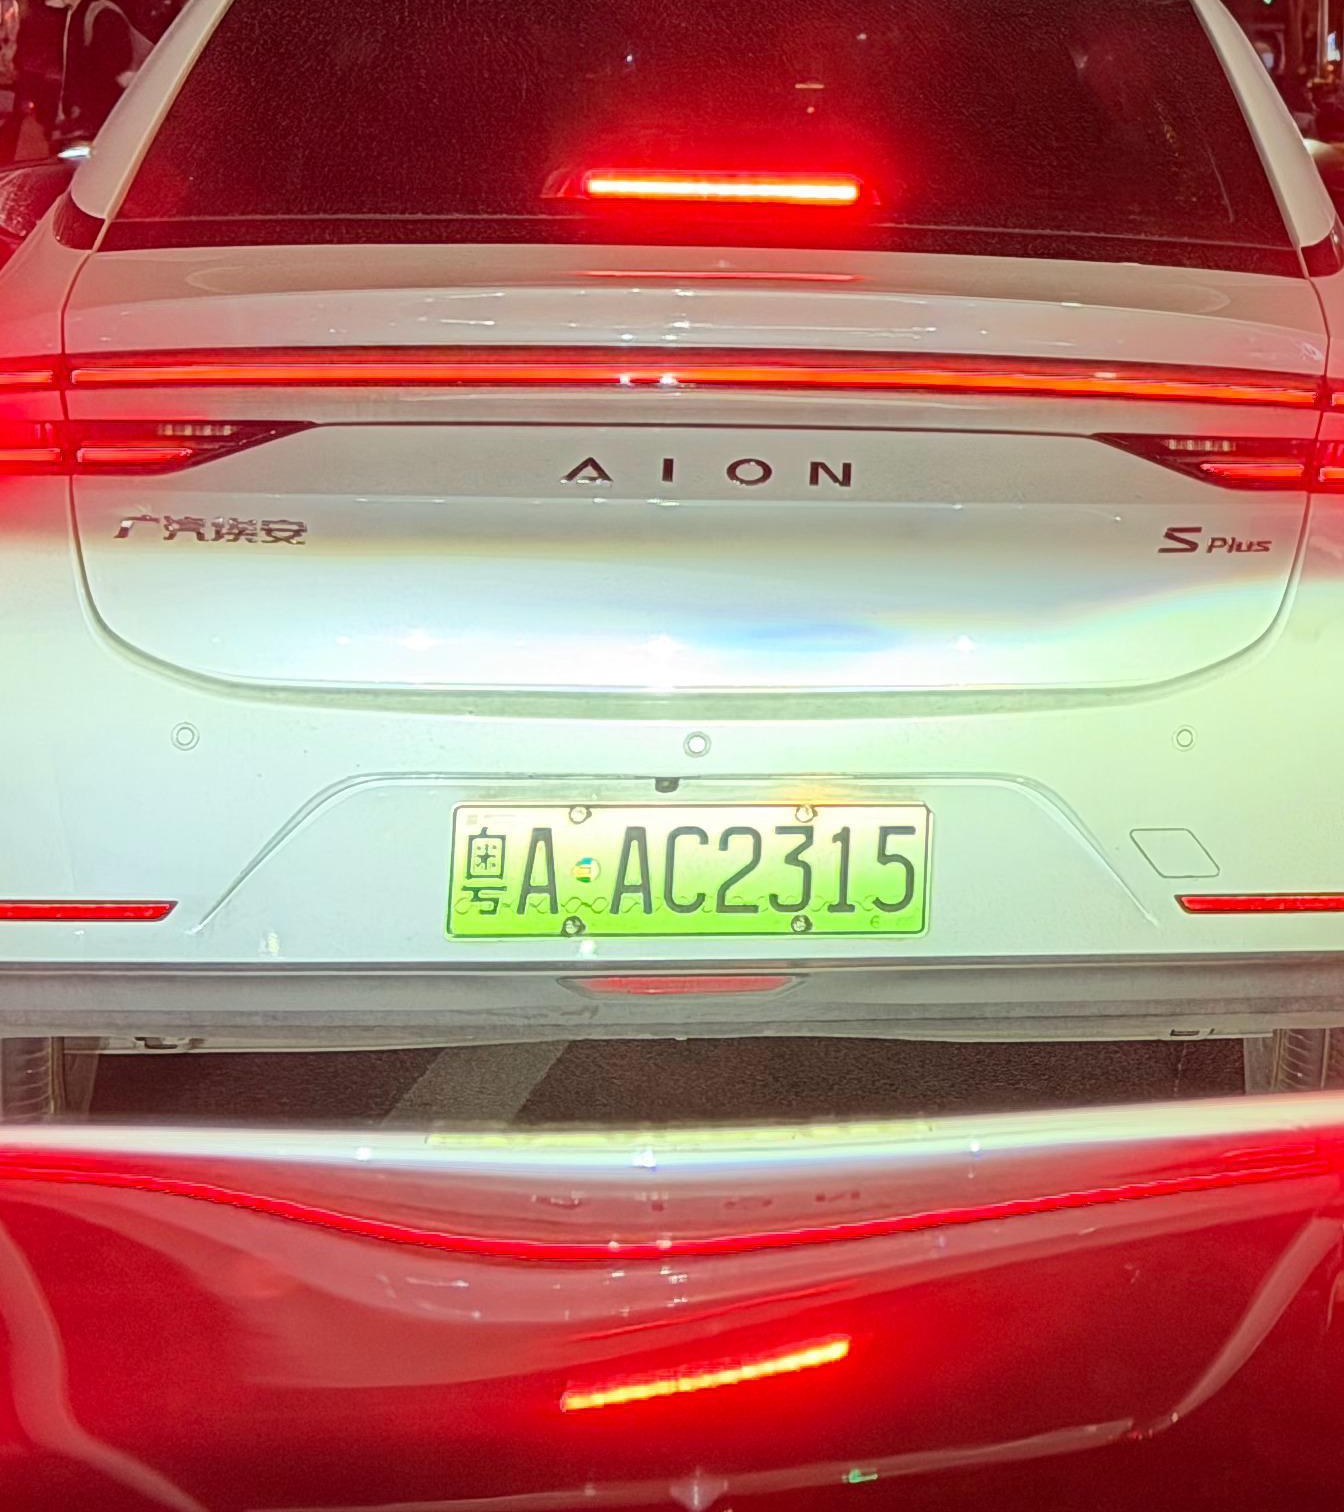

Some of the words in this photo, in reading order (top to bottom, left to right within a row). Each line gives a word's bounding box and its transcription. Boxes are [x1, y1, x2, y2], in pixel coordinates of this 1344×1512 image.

[560, 456, 852, 487] AION
[1158, 526, 1203, 554] S
[1206, 537, 1272, 554] Plus
[610, 825, 917, 915] AC2315
